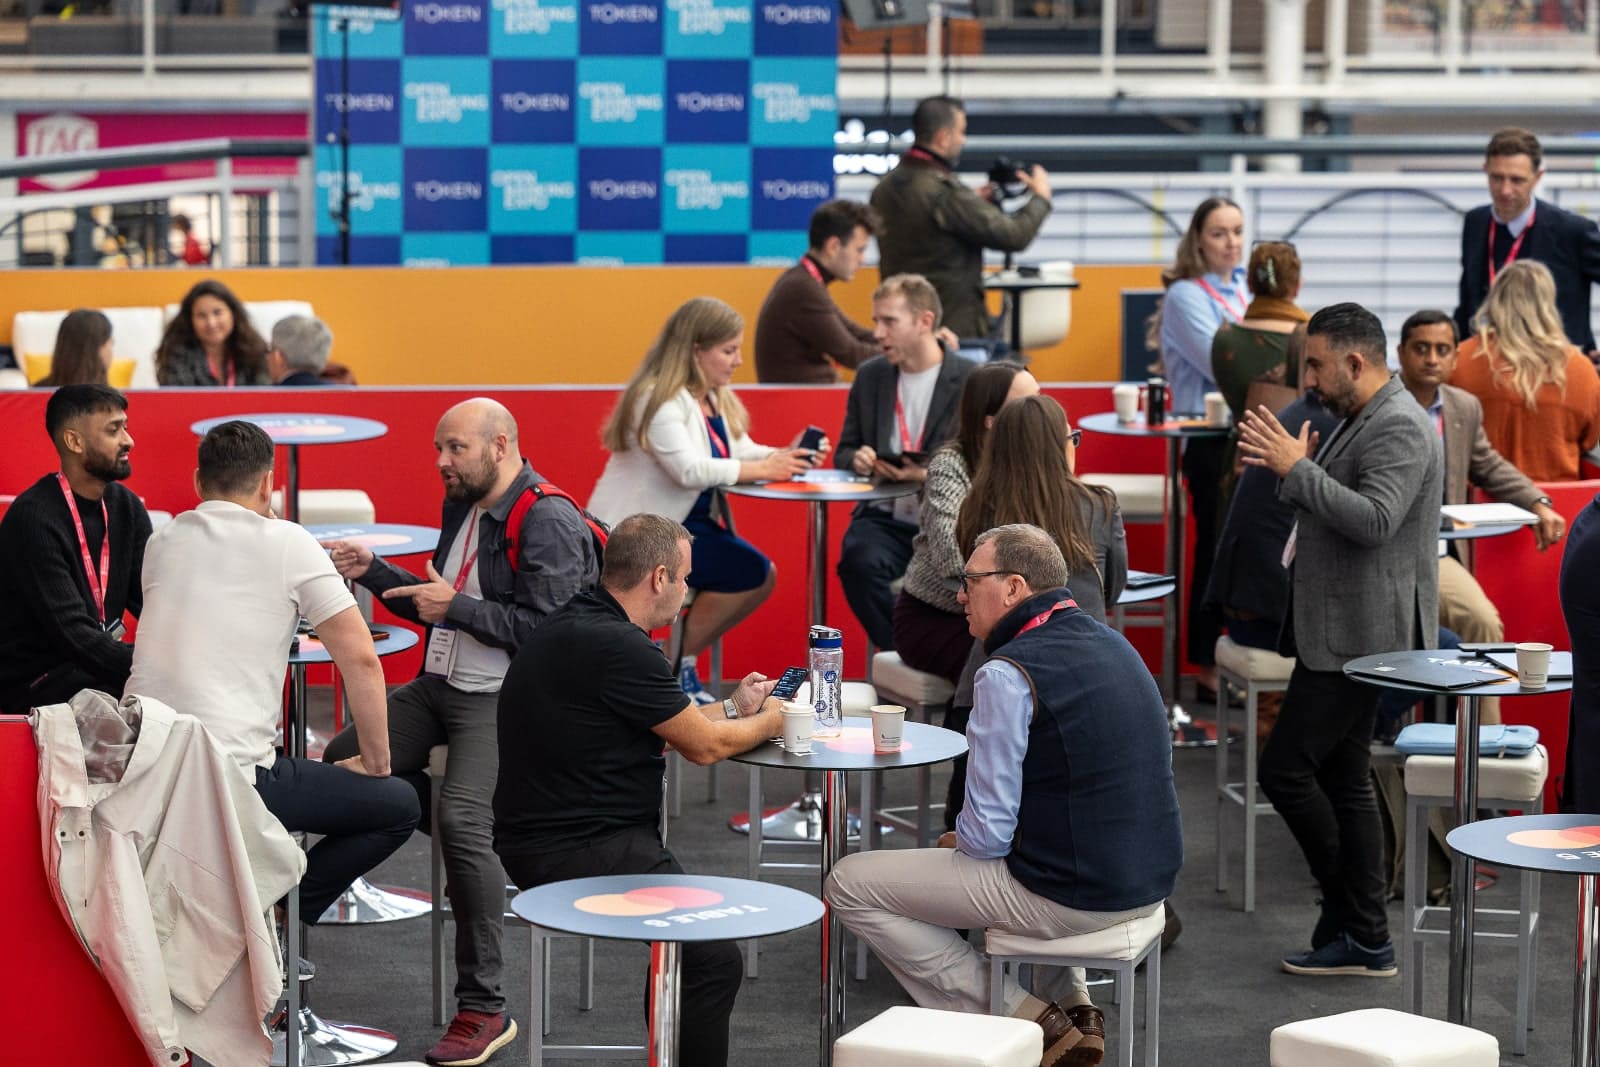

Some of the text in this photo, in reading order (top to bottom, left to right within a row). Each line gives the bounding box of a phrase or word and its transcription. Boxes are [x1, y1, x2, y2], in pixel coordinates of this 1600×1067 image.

[413, 4, 481, 22] TOKEN
[590, 4, 657, 23] TOKEN
[764, 4, 831, 23] TOKEN
[404, 83, 450, 98] OPEN
[579, 83, 625, 98] OPEN
[753, 83, 799, 98] OPEN
[502, 93, 569, 112] TOKEN
[677, 93, 744, 112] TOKEN
[492, 170, 538, 185] OPEN
[665, 170, 711, 185] OPEN
[414, 180, 482, 201] TOKEN
[590, 179, 657, 200] TOKEN
[763, 179, 829, 200] TOKEN
[666, 904, 768, 923] TABLE
